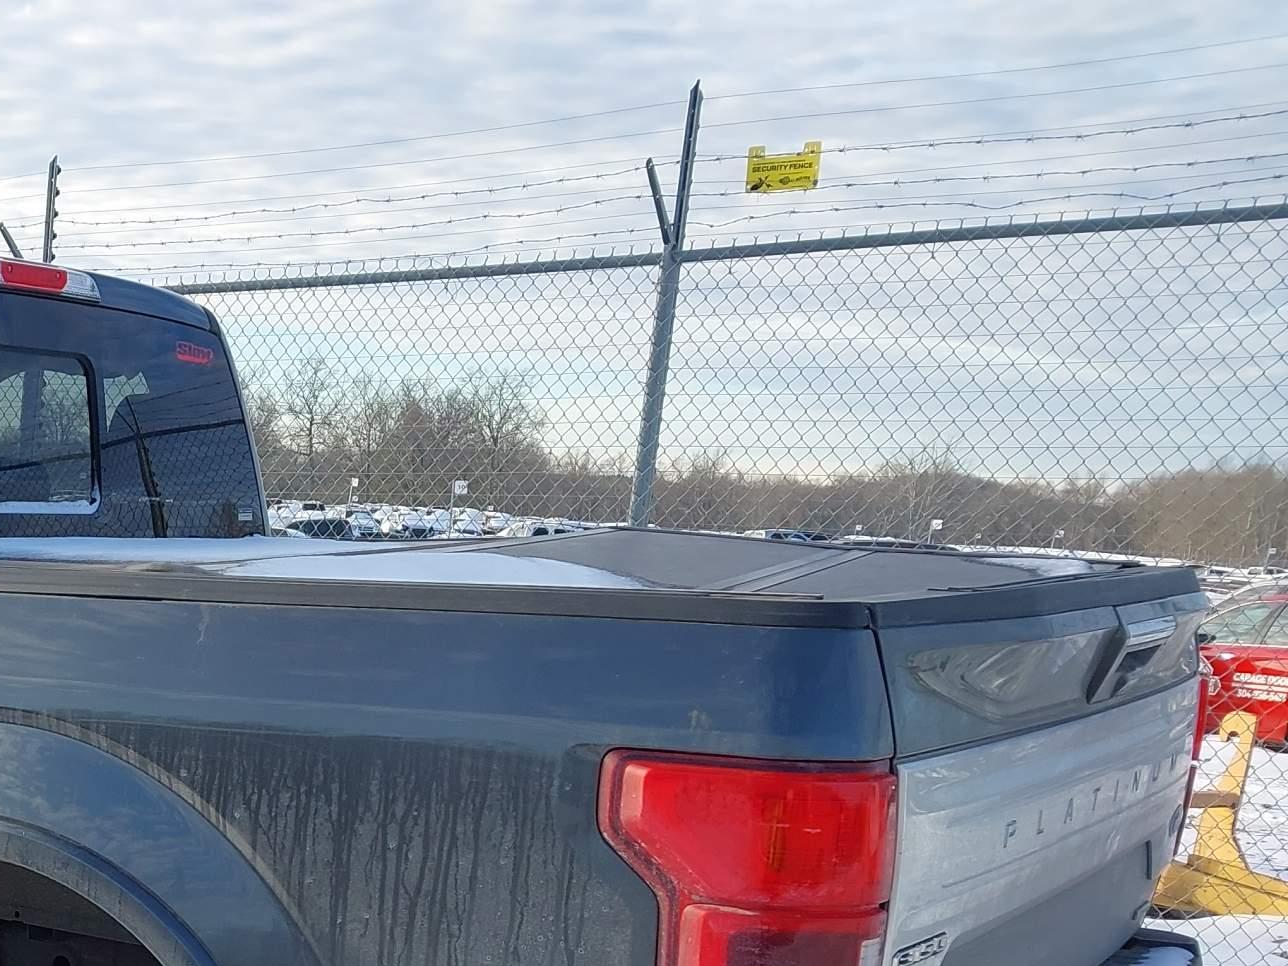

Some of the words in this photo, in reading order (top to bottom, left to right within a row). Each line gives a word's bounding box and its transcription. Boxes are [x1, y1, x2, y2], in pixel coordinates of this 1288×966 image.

[752, 164, 788, 173] SECURITY
[789, 162, 813, 170] FENCE
[1002, 752, 1178, 849] PLATINUM
